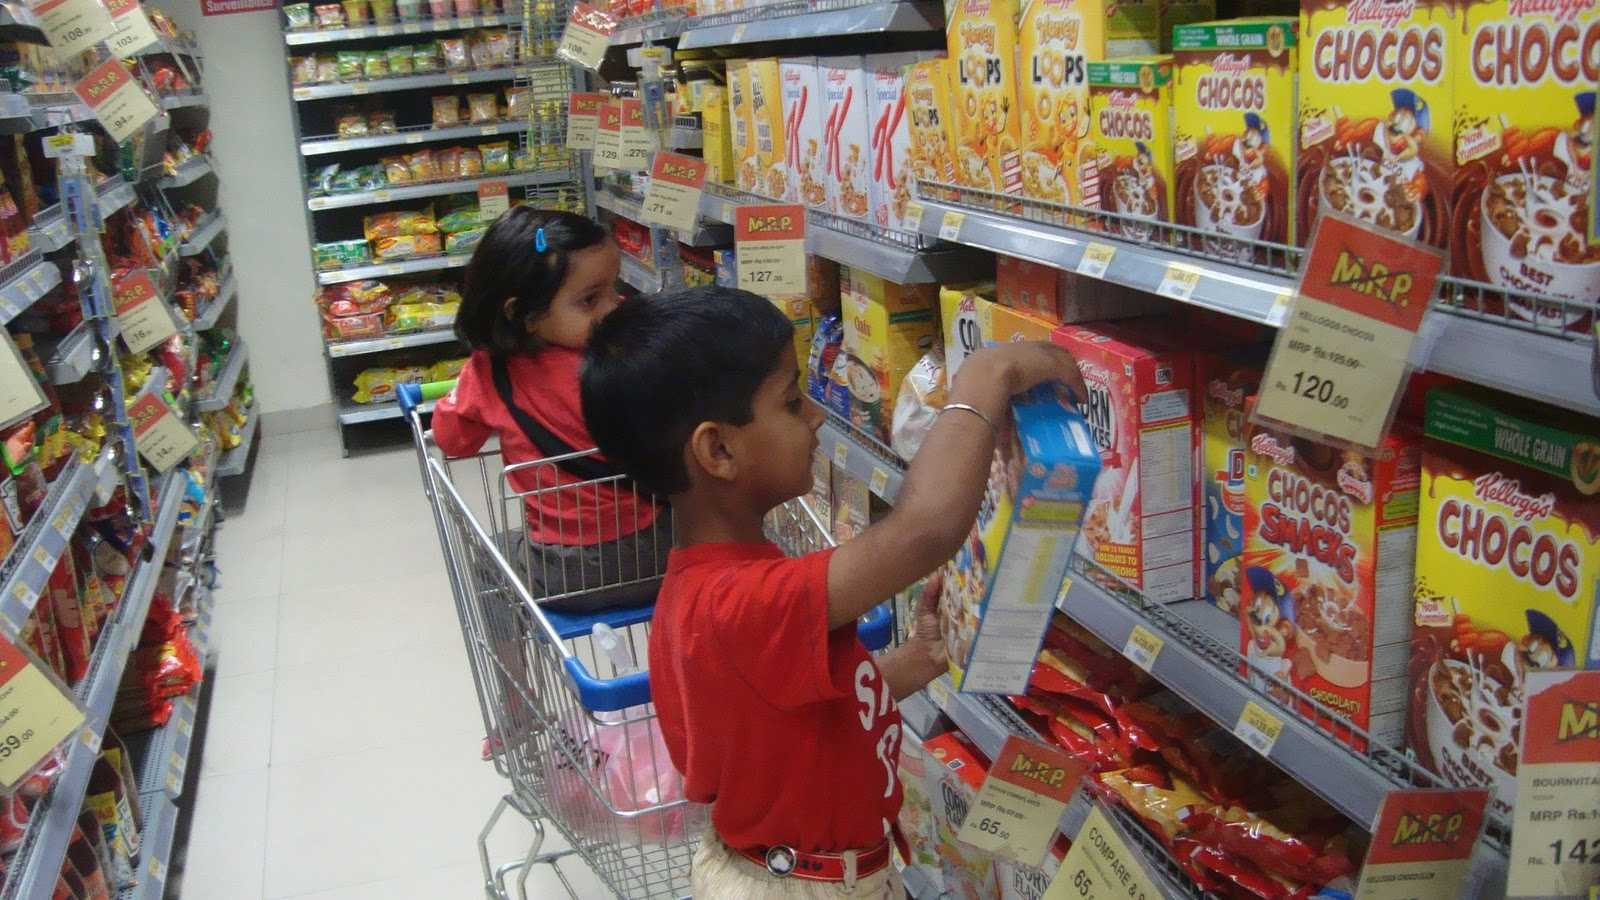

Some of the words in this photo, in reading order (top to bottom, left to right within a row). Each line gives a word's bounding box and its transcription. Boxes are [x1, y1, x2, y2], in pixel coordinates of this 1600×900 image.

[1348, 0, 1412, 28] Kellogg's
[1313, 25, 1445, 84] CHOCOS
[1197, 74, 1265, 111] CHOCOS
[1099, 110, 1153, 140] CHOCOS
[748, 216, 793, 234] M.R.P.
[1330, 250, 1414, 309] M.R.P.
[1494, 427, 1532, 456] WHOLE
[1533, 439, 1567, 468] GRAIN
[1267, 466, 1352, 536] CHOCOS
[1475, 472, 1555, 522] Kellogg's
[1259, 502, 1357, 584] SMACKS
[1438, 497, 1581, 601] CHOCOS
[1010, 752, 1066, 788] M.R.P.
[1530, 811, 1562, 822] MRP
[1089, 827, 1131, 887] COMPARE
